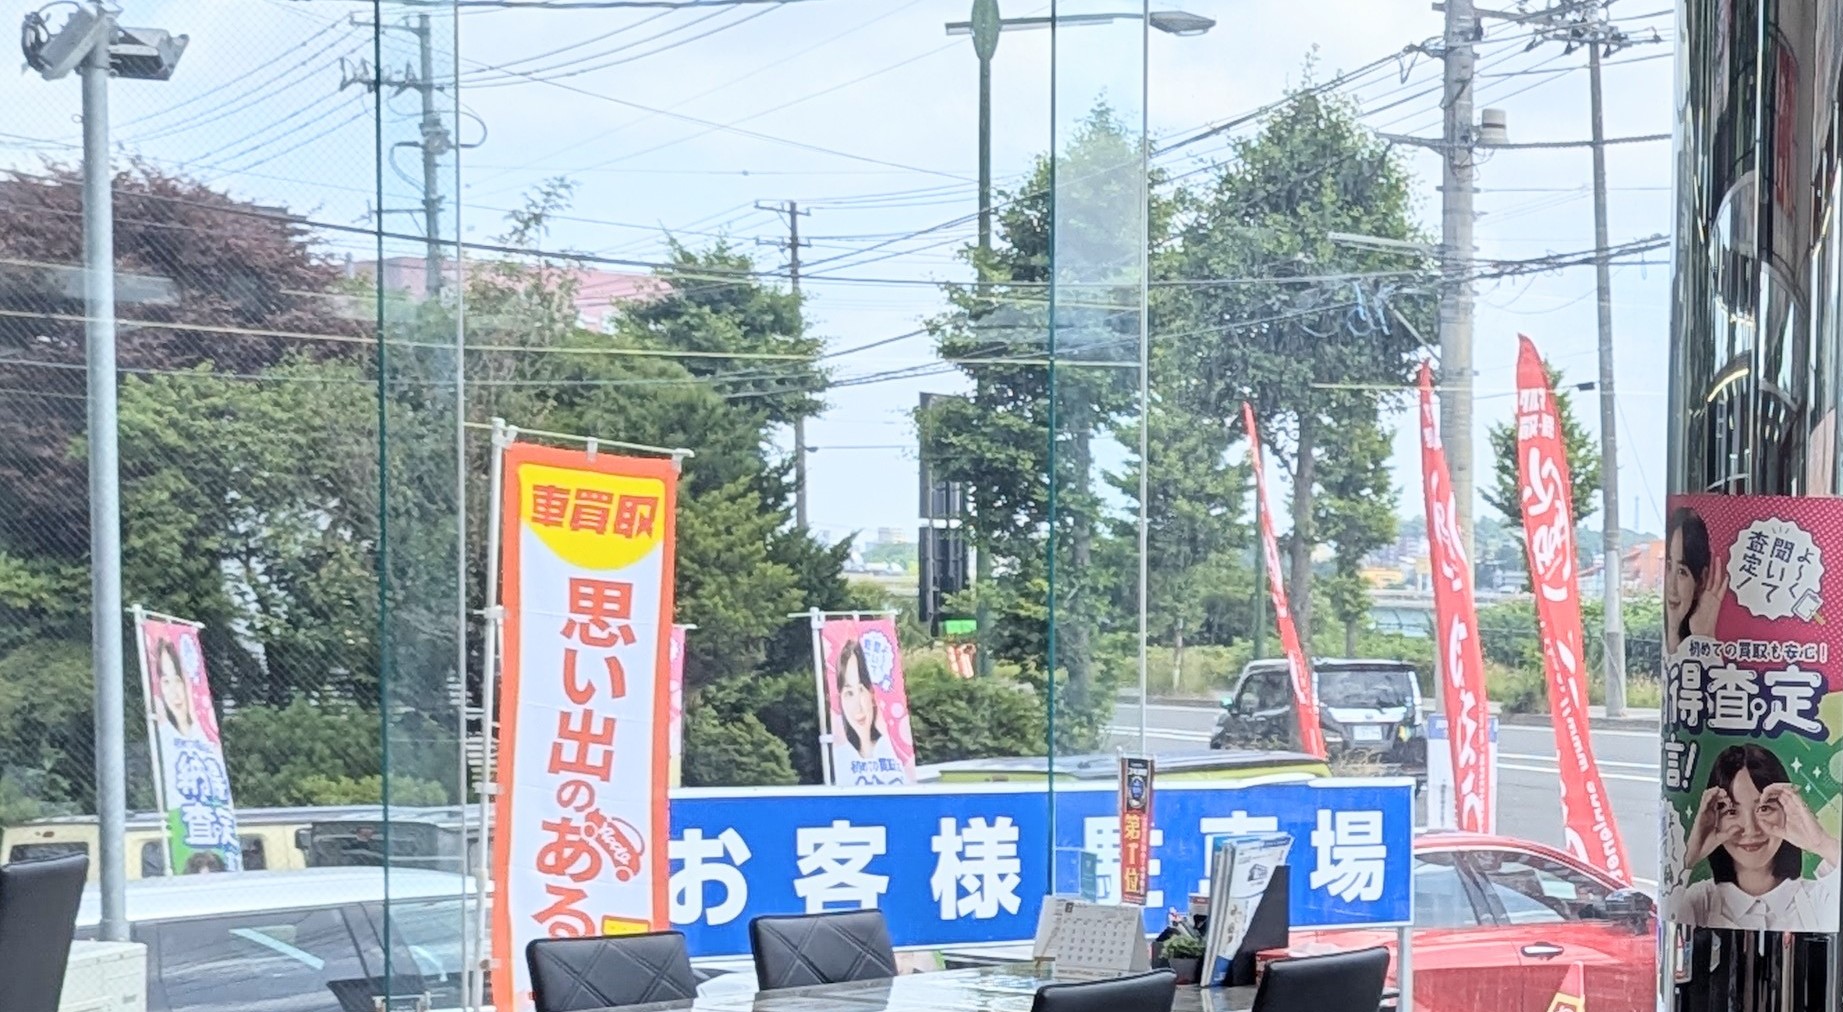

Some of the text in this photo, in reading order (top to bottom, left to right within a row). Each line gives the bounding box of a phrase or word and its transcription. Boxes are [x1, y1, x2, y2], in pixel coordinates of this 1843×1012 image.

[531, 485, 660, 540] 車買取
[1761, 537, 1796, 603] 聞いて
[1688, 640, 1828, 664] 初めての買取も安心!
[1662, 665, 1824, 733] 得査定
